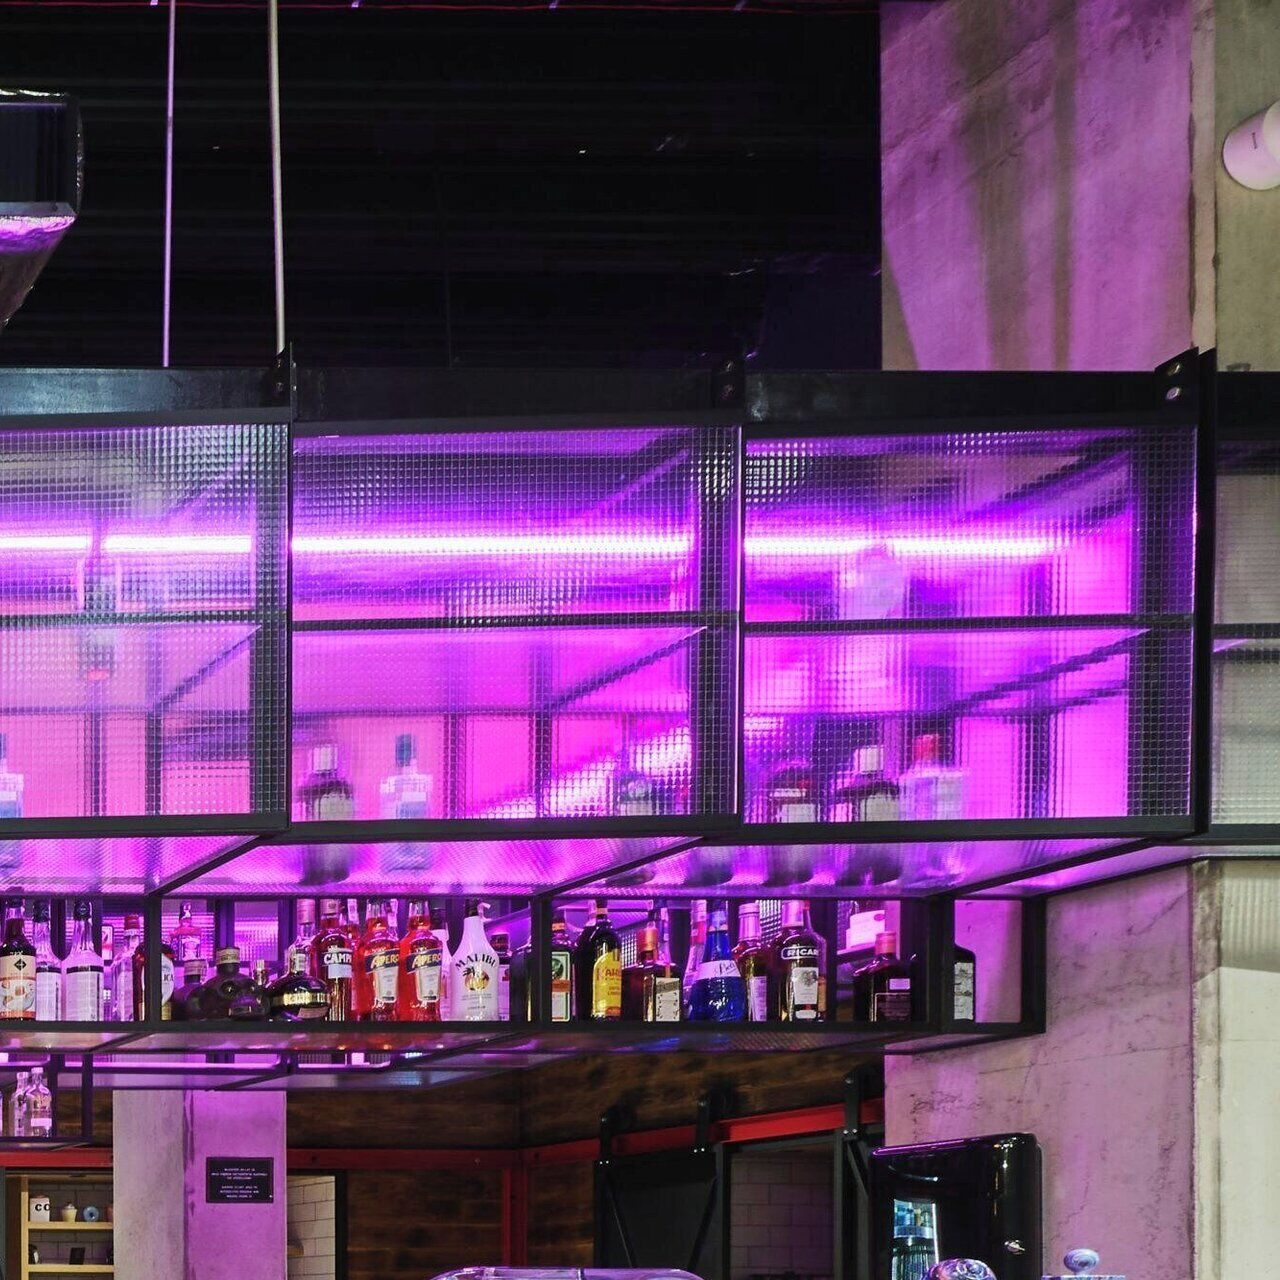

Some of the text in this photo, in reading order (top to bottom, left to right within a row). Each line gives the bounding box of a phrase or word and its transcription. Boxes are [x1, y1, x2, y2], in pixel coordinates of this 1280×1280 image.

[371, 953, 399, 969] APERO
[412, 953, 441, 969] APERO
[787, 948, 820, 958] RICAR
